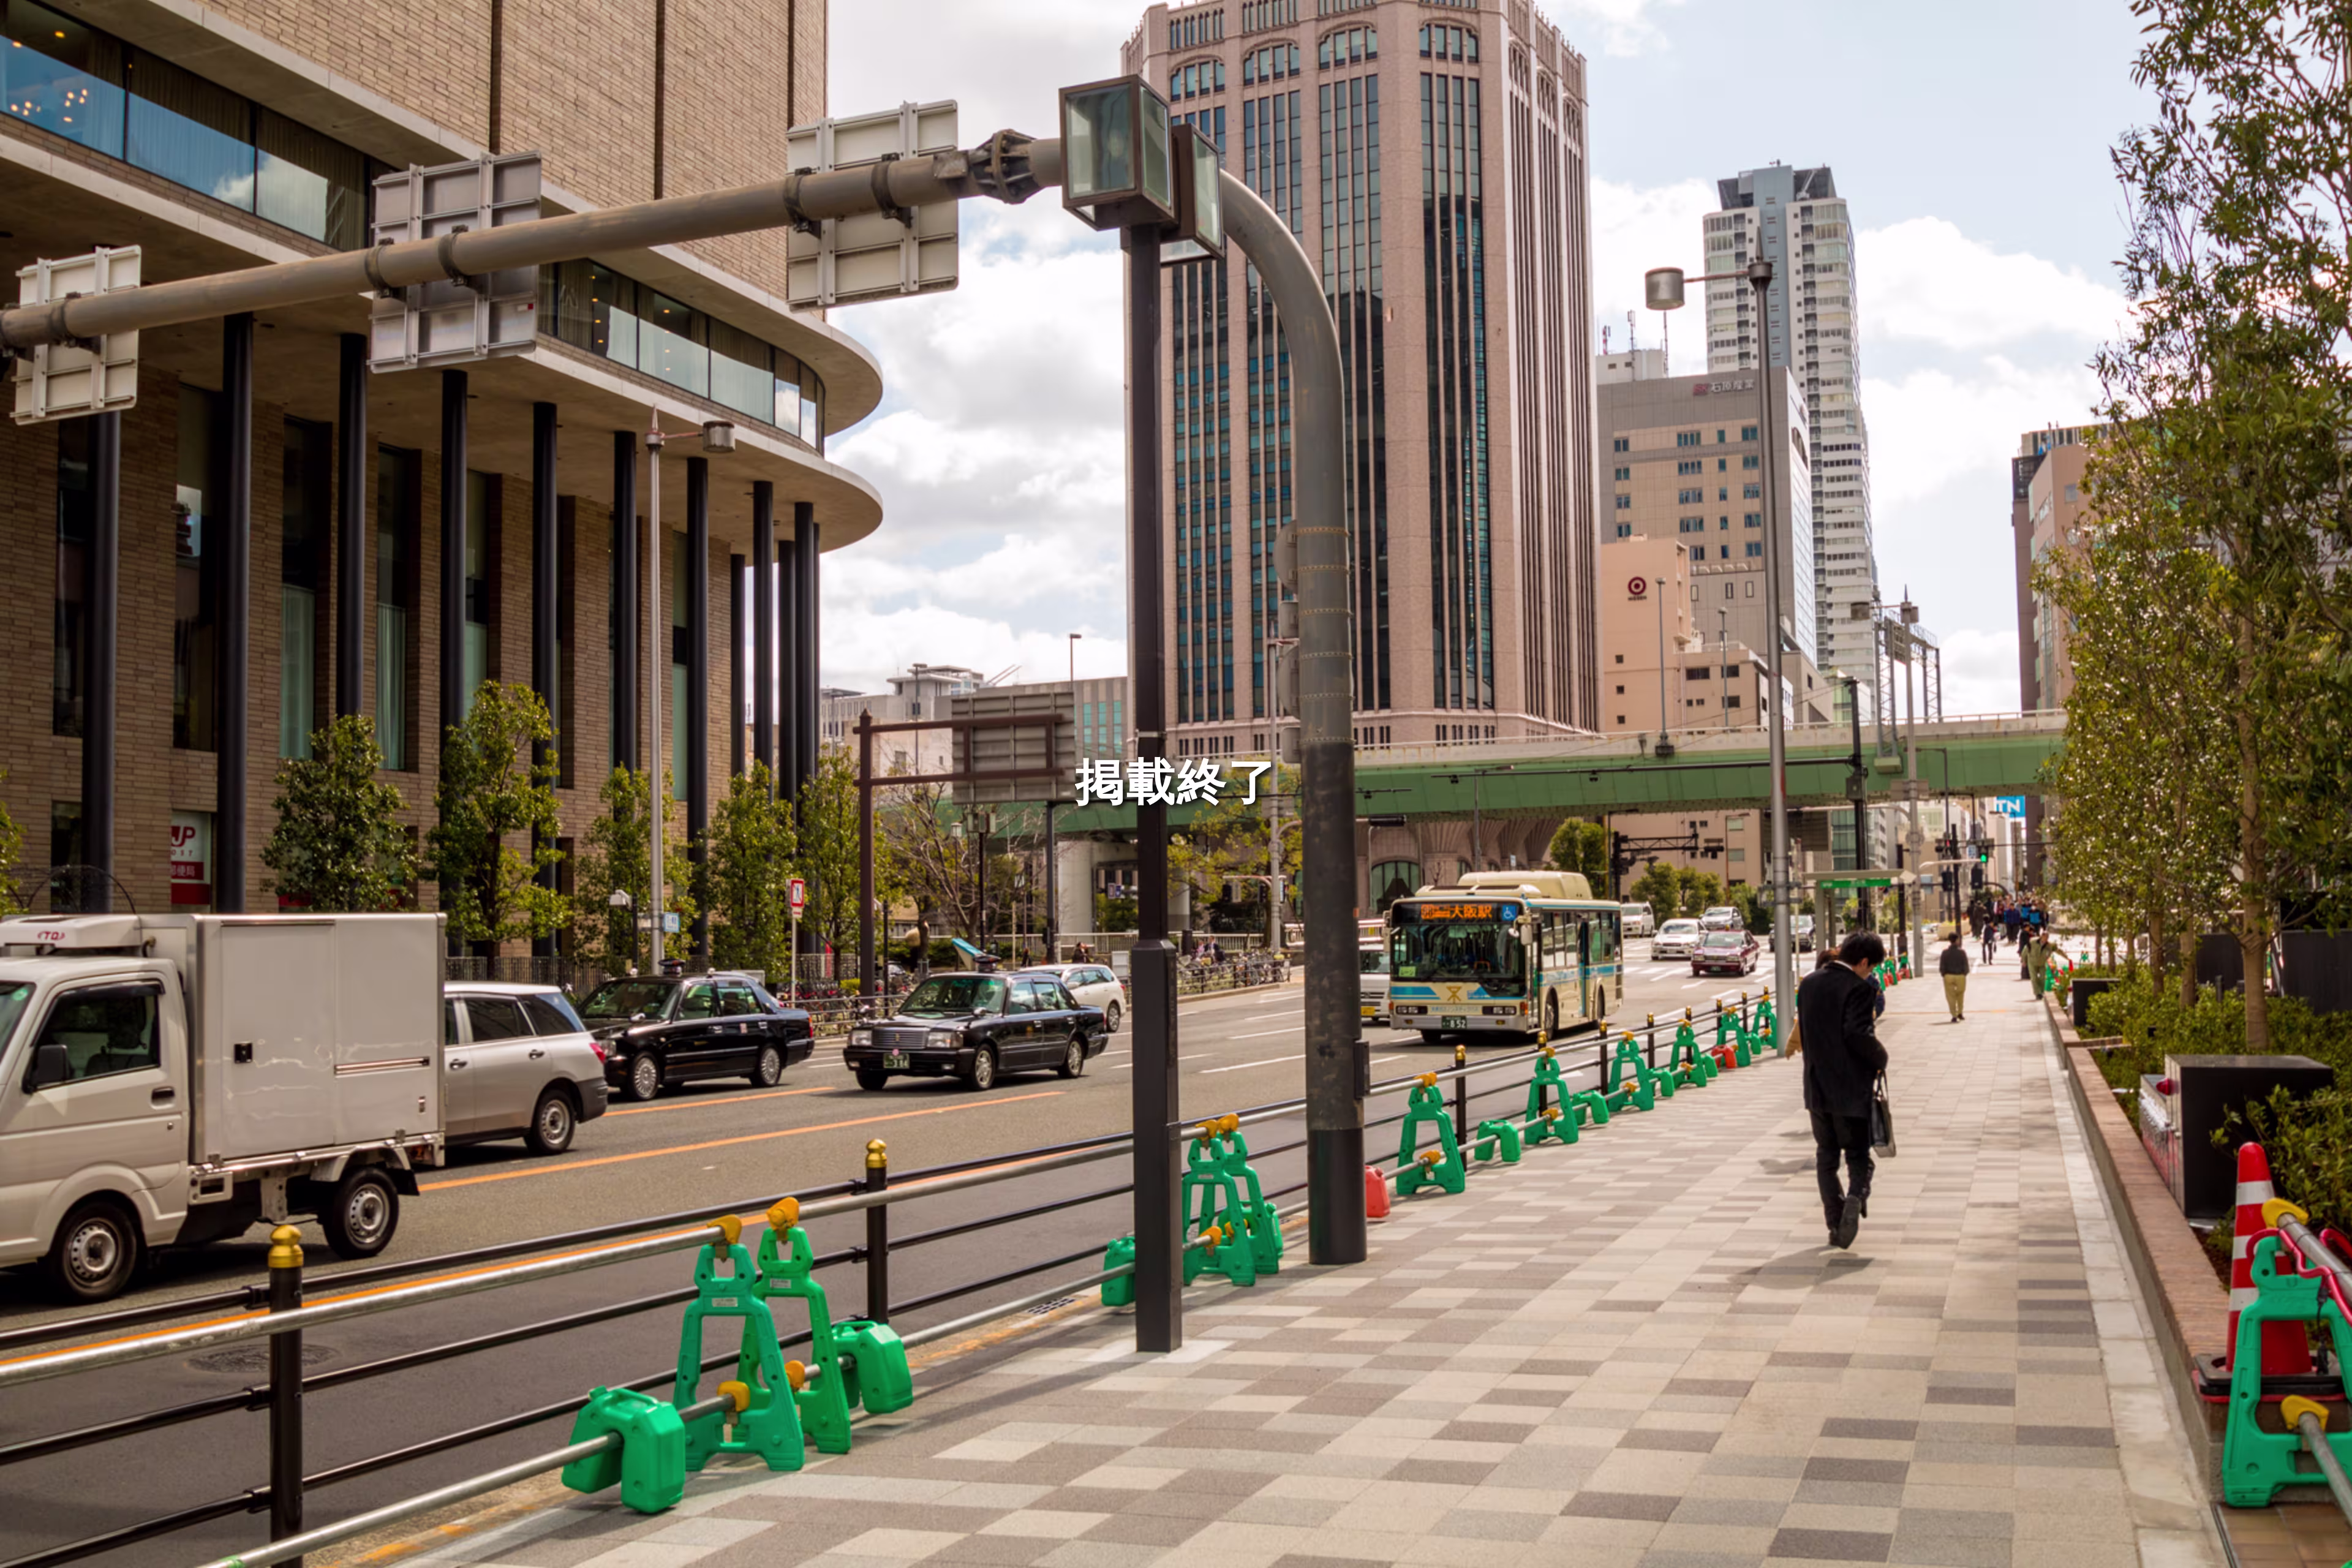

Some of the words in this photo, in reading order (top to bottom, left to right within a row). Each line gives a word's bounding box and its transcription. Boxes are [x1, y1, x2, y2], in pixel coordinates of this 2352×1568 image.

[1710, 379, 1754, 393] 石原産業
[1450, 903, 1493, 919] 大阪駅
